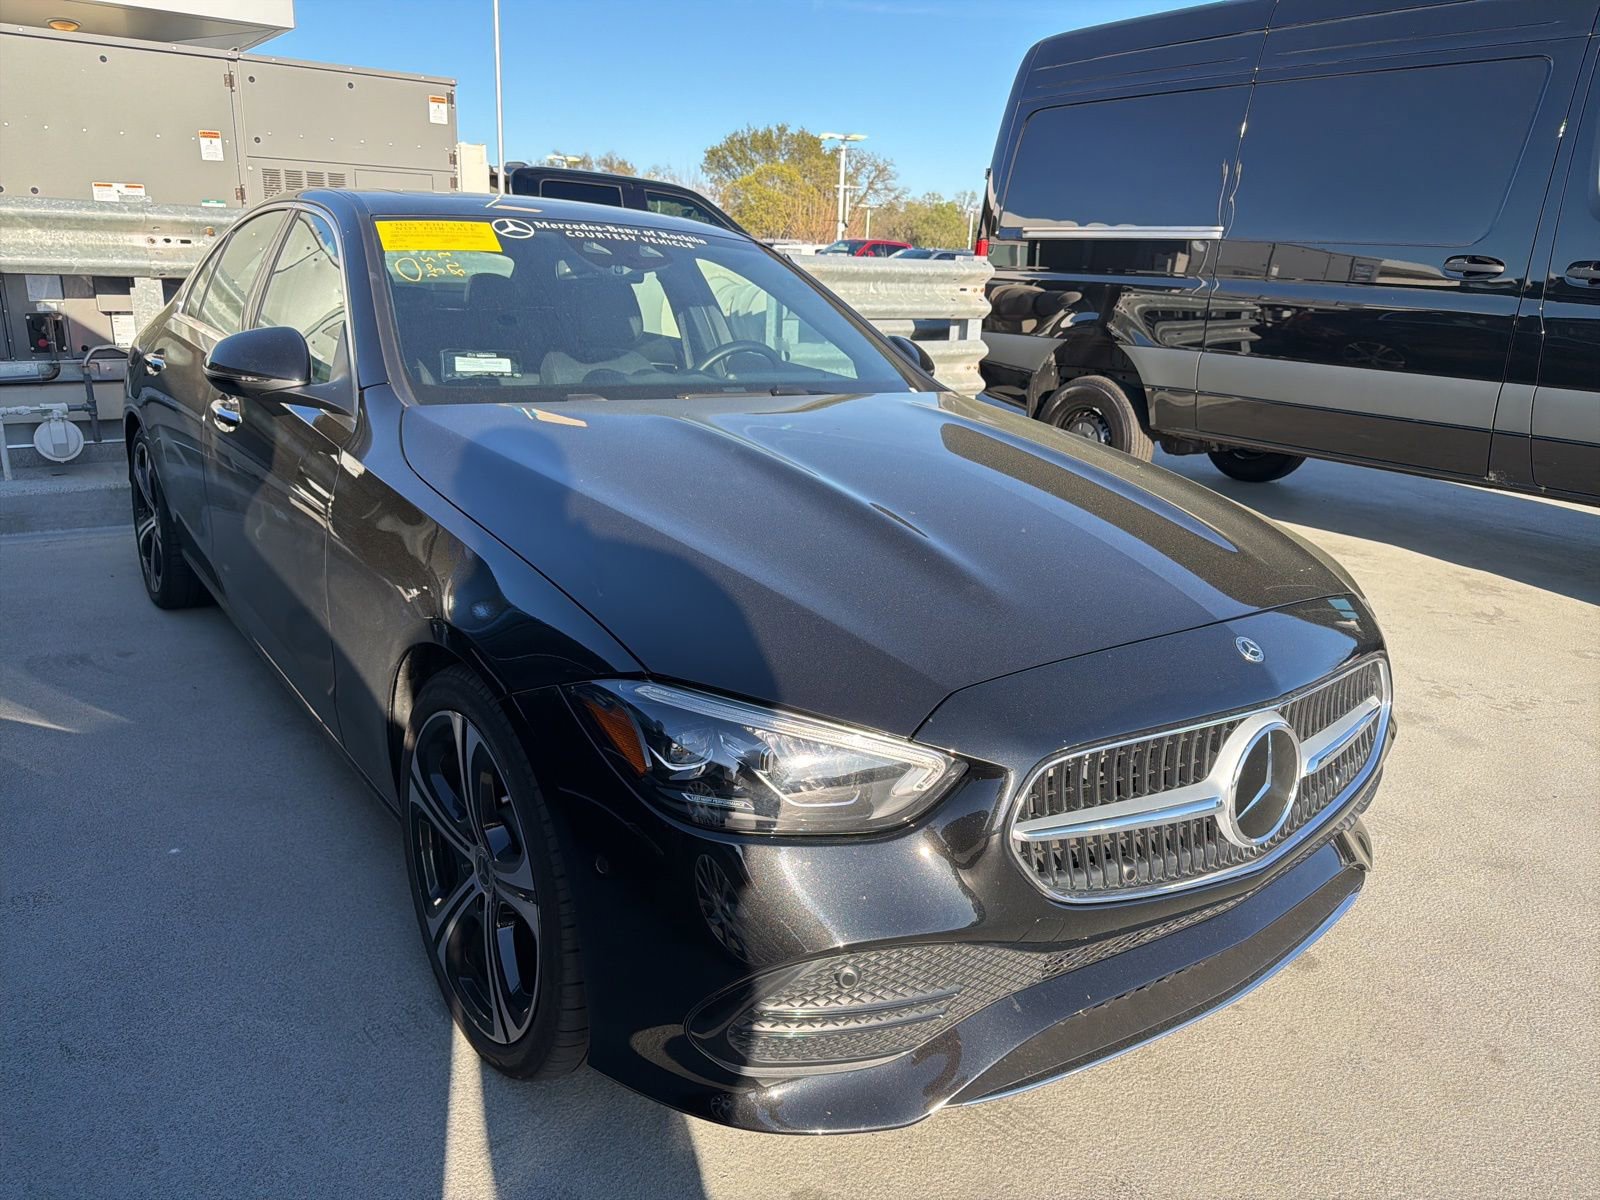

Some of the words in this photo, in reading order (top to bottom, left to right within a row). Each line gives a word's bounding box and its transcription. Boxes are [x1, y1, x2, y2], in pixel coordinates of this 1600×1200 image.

[534, 221, 641, 236] Mercedes-Benz
[643, 229, 657, 239] of
[657, 231, 708, 246] Rocklin
[565, 230, 637, 243] COURTESY
[640, 235, 696, 250] VEHICLE
